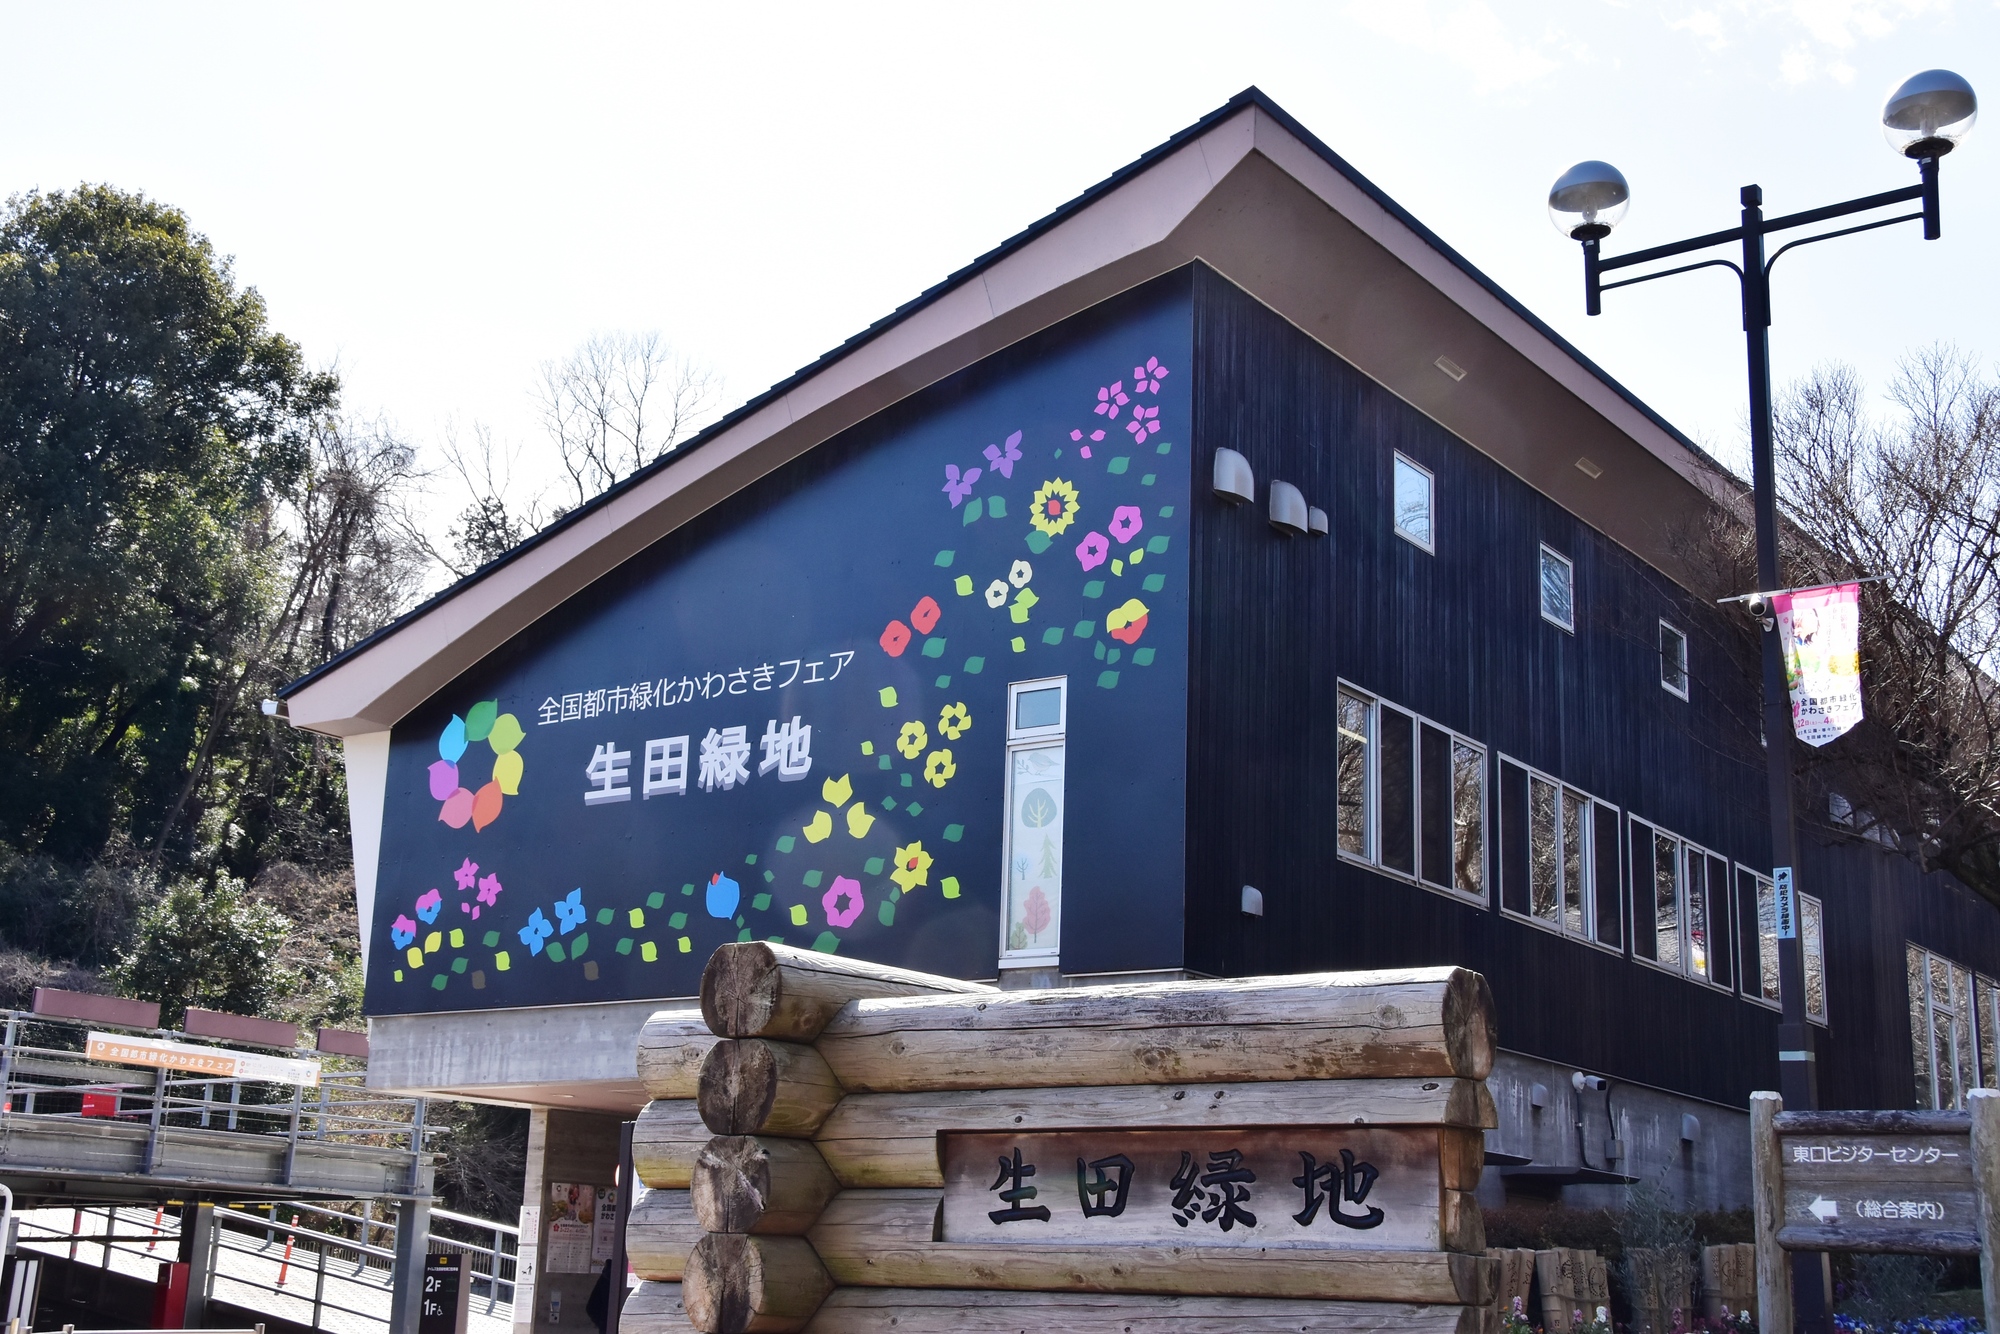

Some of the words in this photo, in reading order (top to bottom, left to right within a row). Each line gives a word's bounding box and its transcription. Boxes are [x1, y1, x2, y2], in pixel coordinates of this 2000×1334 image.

[537, 650, 855, 726] 全国都市緑化かわさきフェア
[1800, 692, 1858, 707] 全国都市緑化
[1800, 702, 1858, 716] かわさきフェア
[584, 715, 813, 806] 生田緑地
[109, 1046, 234, 1071] 全国都市緑化かわさきフェア
[1792, 1146, 1960, 1163] 東口ビジターセンター
[987, 1146, 1385, 1232] 生田緑地
[425, 1275, 442, 1293] 2F
[423, 1298, 438, 1316] 1F
